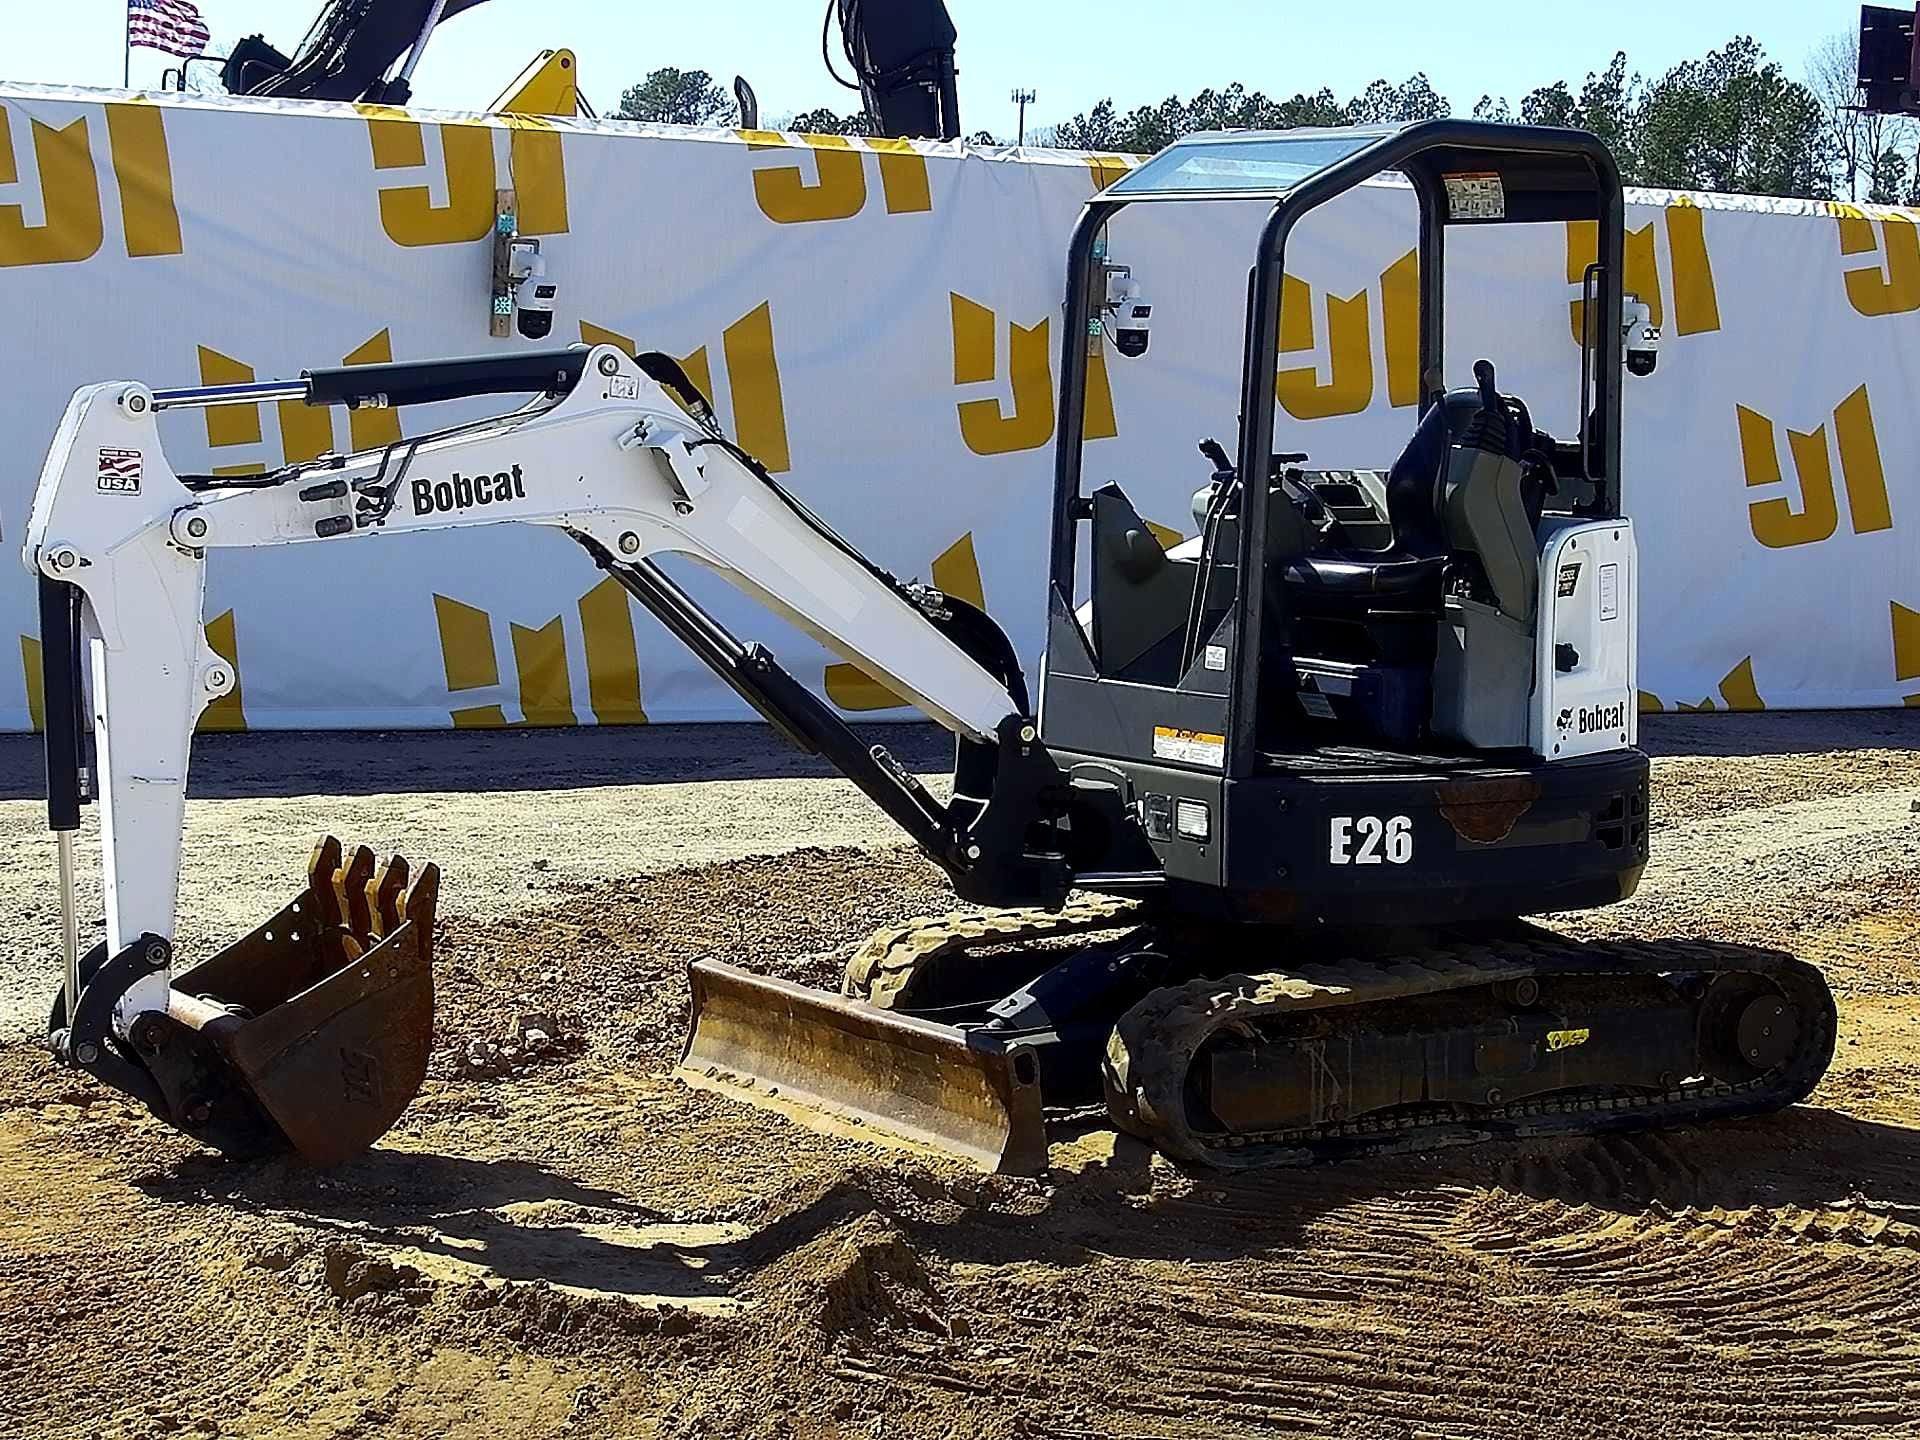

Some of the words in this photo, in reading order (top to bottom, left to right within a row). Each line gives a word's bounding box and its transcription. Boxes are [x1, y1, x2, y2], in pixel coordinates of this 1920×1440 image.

[99, 478, 137, 490] USA
[411, 463, 526, 516] Bobcat
[1578, 701, 1624, 734] Bobcat
[1330, 815, 1413, 864] E26
